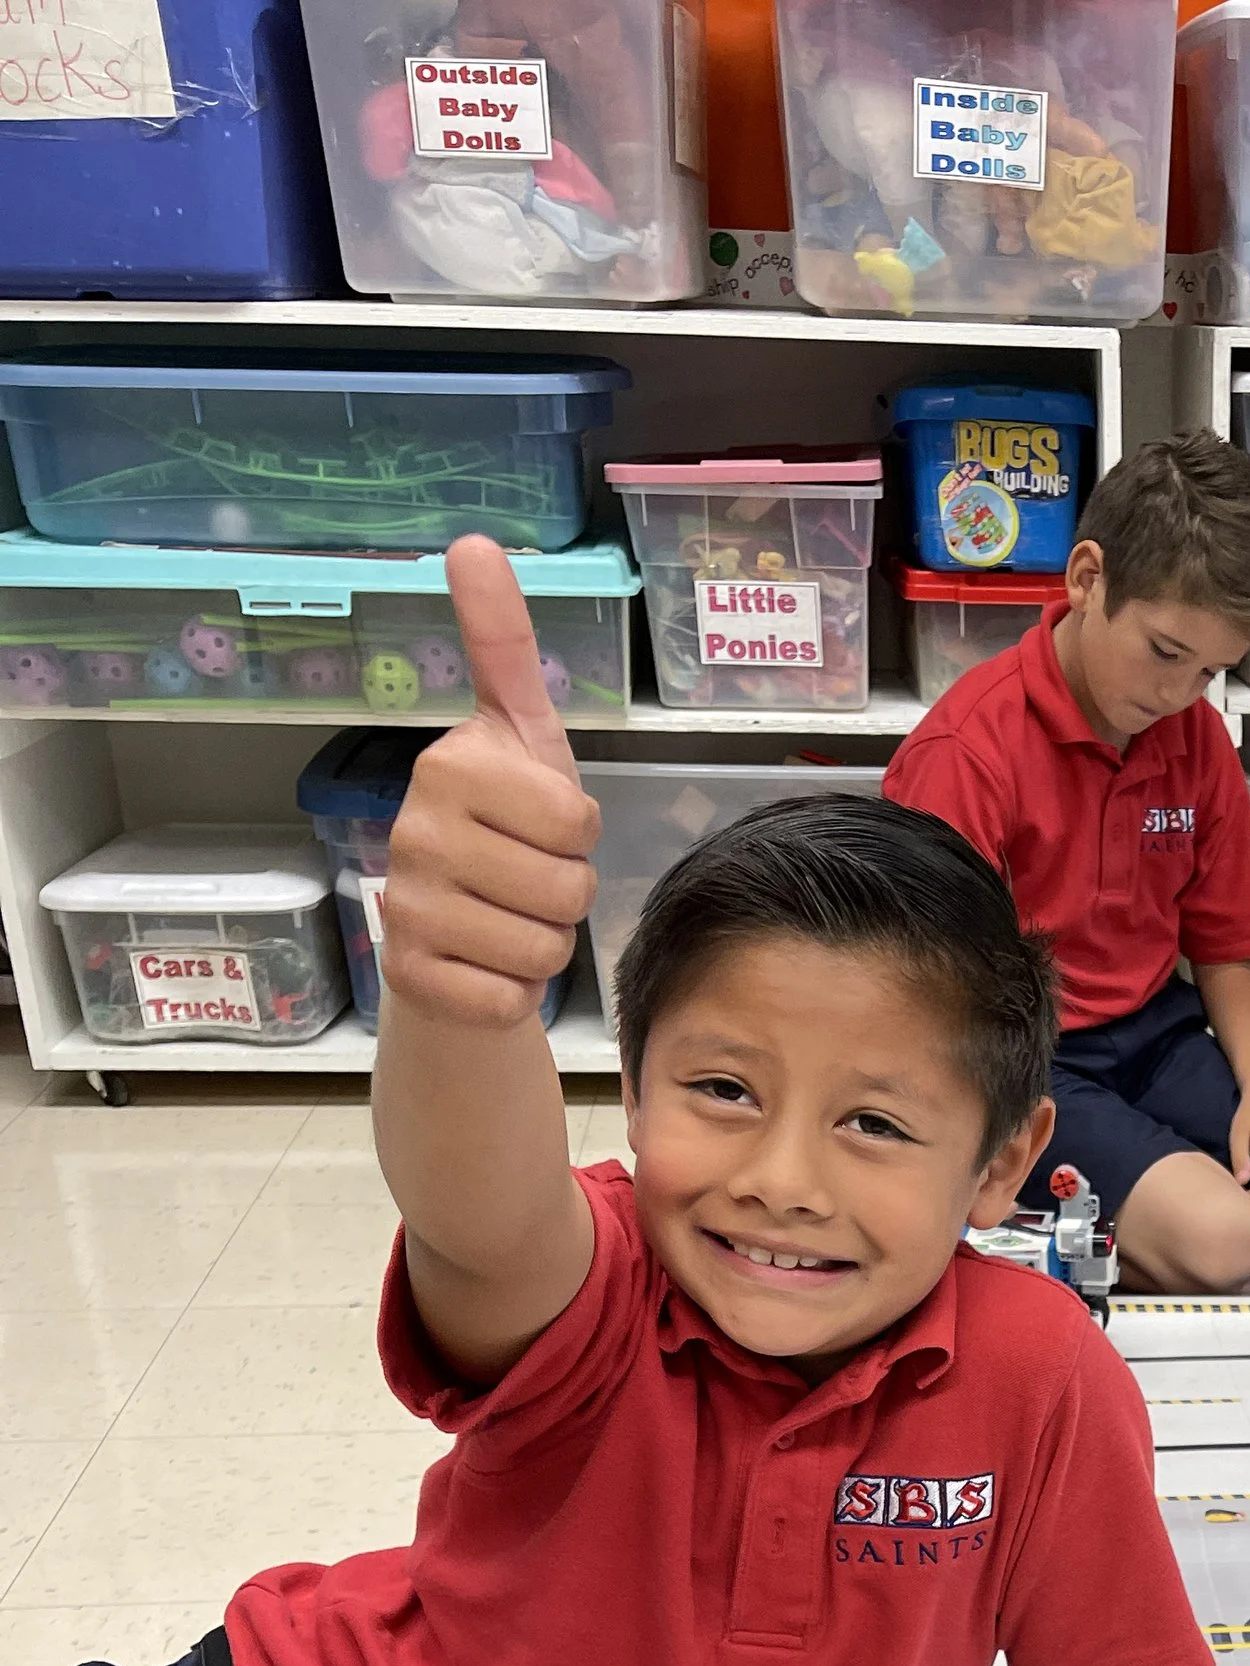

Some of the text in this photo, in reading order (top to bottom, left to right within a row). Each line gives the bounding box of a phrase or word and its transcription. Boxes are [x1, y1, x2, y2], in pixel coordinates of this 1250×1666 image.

[415, 64, 538, 86] Outside
[438, 97, 518, 122] Baby
[921, 86, 1039, 115] Inside
[442, 130, 522, 150] Dolls
[930, 120, 1028, 151] Baby
[931, 153, 1027, 180] Dolls
[958, 420, 1060, 476] BUGS
[993, 470, 1070, 497] BUILDING
[707, 586, 798, 614] Little
[705, 633, 818, 661] Ponies
[140, 954, 244, 981] Cars &
[146, 997, 253, 1024] Trucks
[836, 1479, 990, 1528] SBS
[835, 1530, 988, 1567] SAINTS
